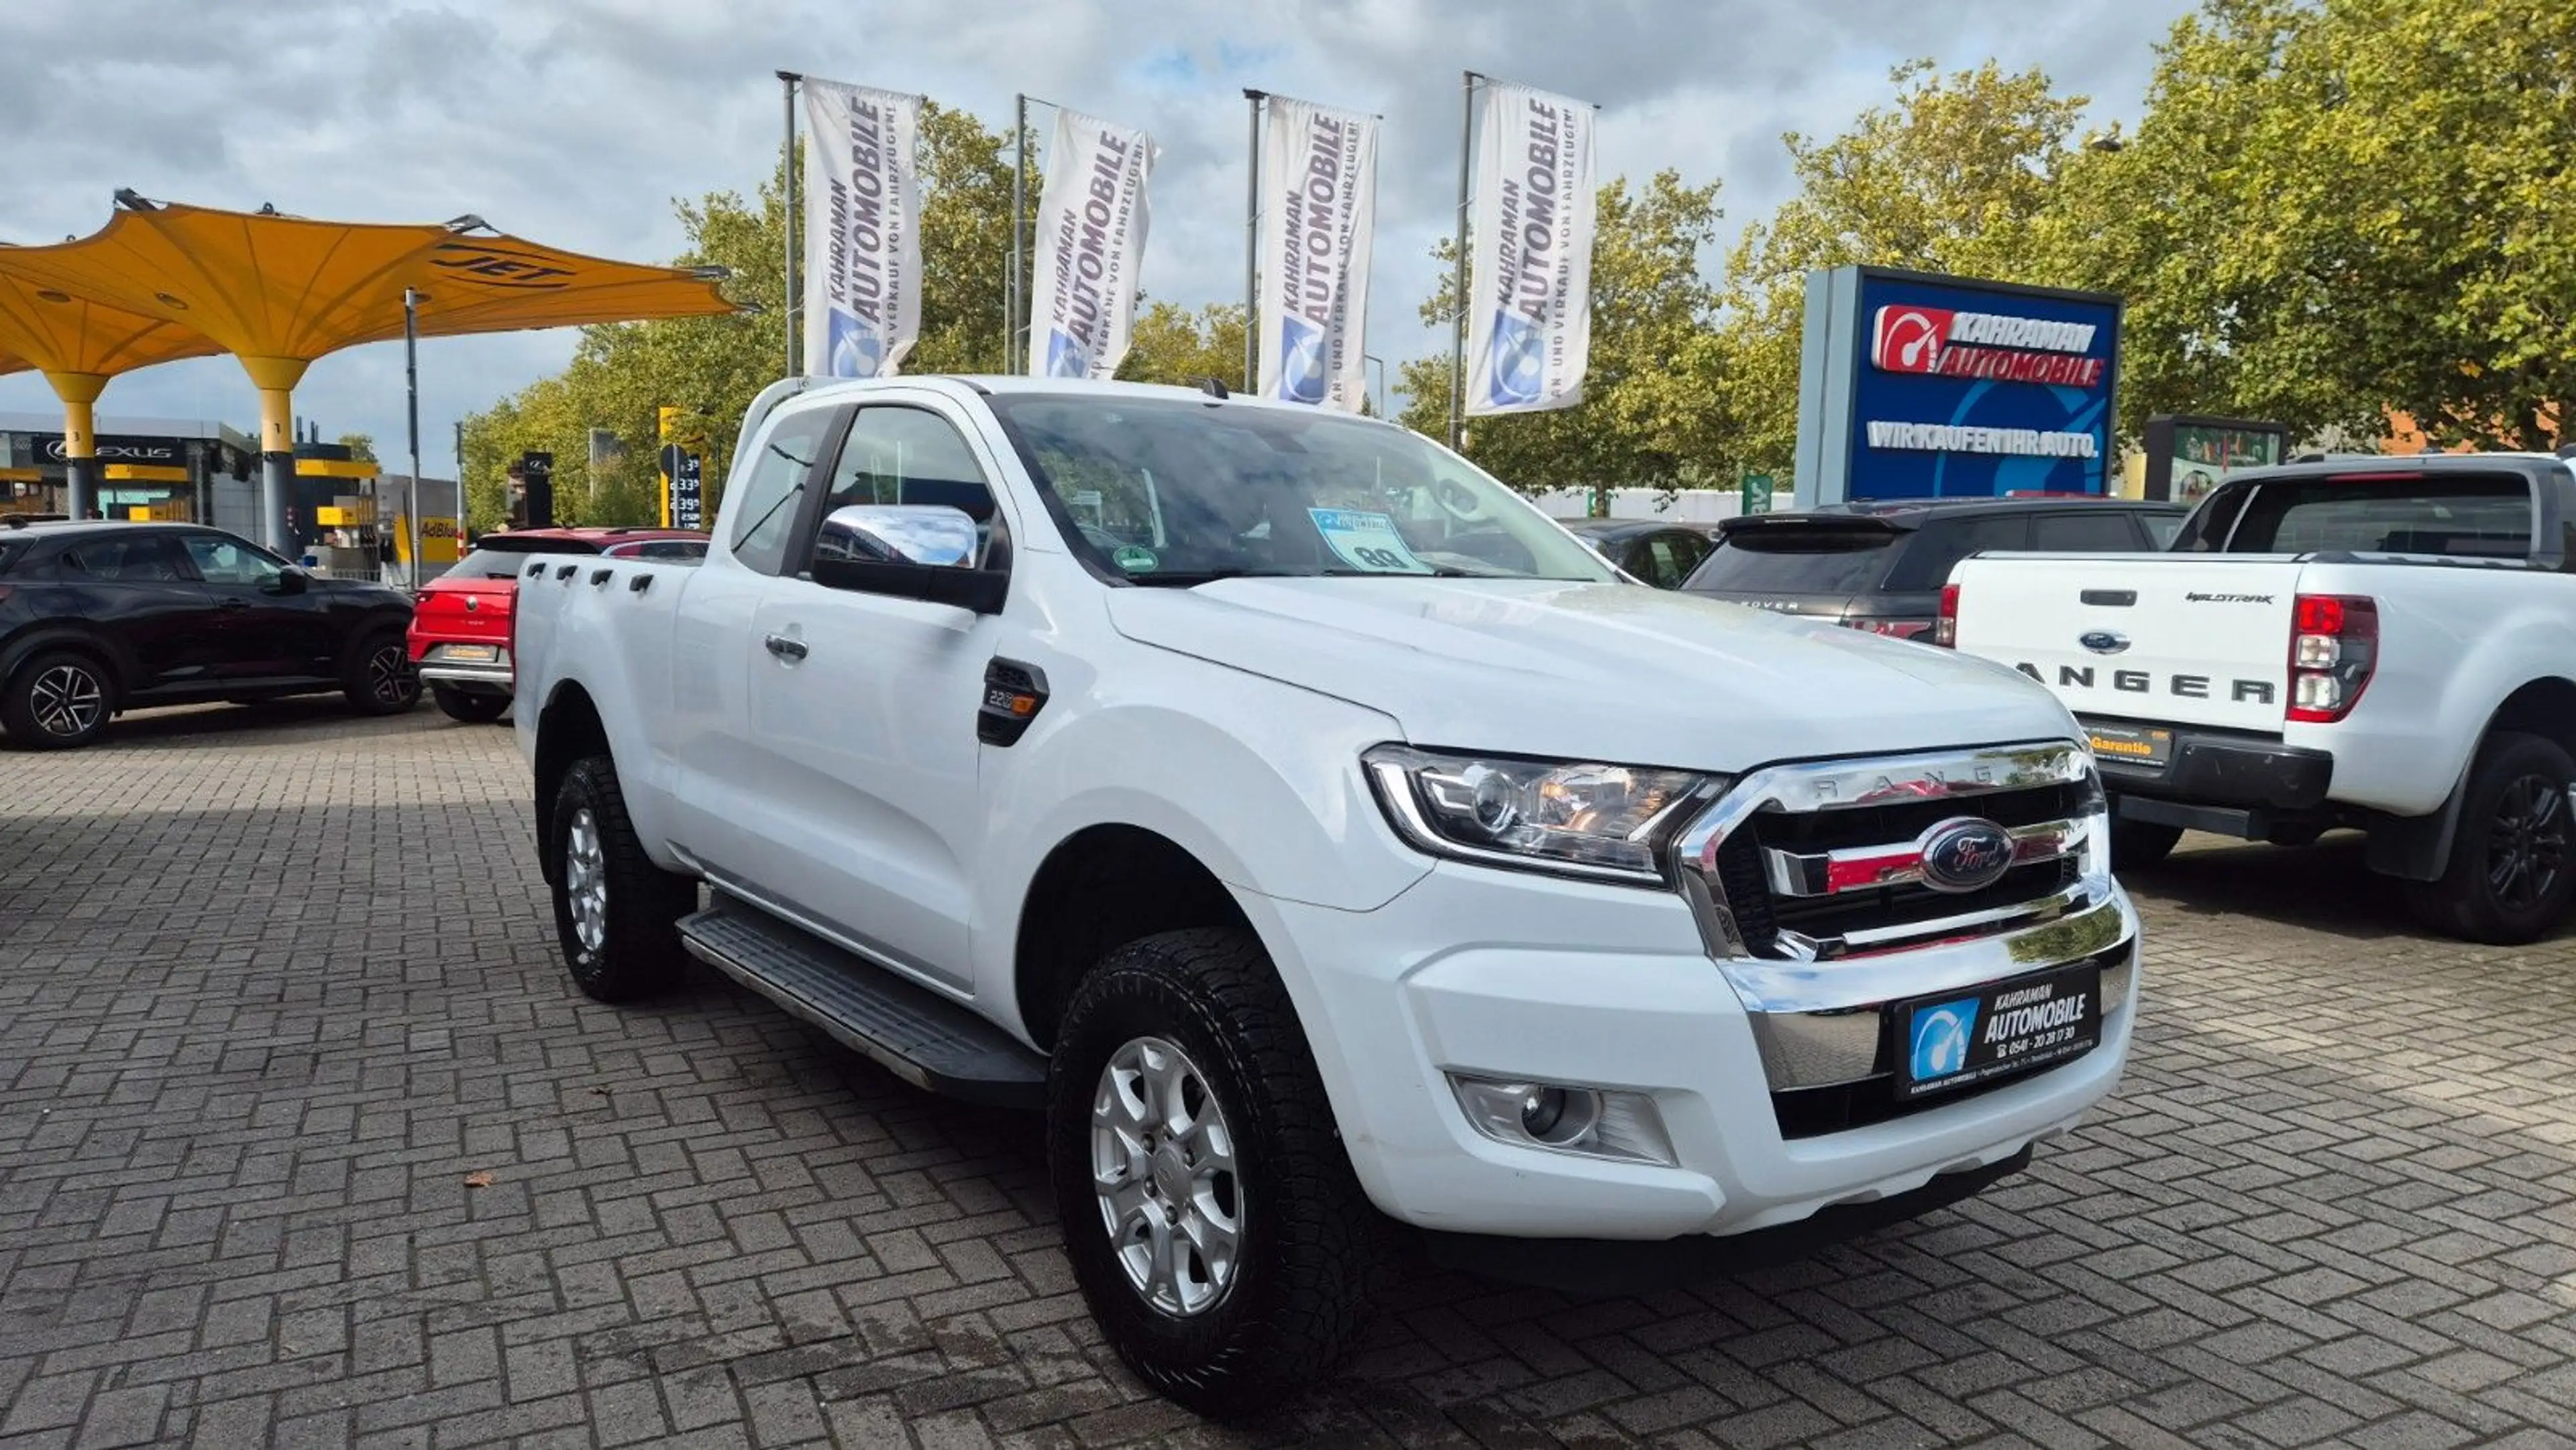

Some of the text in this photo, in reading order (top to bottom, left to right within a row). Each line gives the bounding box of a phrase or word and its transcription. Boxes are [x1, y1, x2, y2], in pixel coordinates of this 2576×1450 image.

[850, 97, 881, 325] AUTOMOBILE
[1305, 113, 1340, 327] AUTOMOBILE
[1519, 97, 1557, 323] AUTOMOBILE
[829, 178, 847, 304] KAHRAMAN
[888, 221, 900, 253] VON
[1067, 130, 1127, 347] AUTOMOBILE
[1283, 190, 1302, 312] KAHRAMAN
[1498, 178, 1519, 304] KAHRAMAN
[428, 256, 578, 280] JET
[1053, 208, 1077, 324] KAHRAMAN
[1108, 250, 1122, 282] VON
[887, 260, 899, 331] VERKAUF
[1552, 335, 1564, 366] UND
[1560, 217, 1572, 249] VON
[1947, 312, 2097, 353] KAHRAMAN
[1332, 339, 1344, 370] UND
[1937, 345, 2106, 388] AUTOMOBILE
[95, 445, 172, 458] EXUS
[1867, 421, 1913, 448] WIR
[1914, 423, 2004, 454] KAUFEN
[2004, 428, 2039, 455] IHR
[2016, 662, 2275, 704] ANGER
[2090, 736, 2152, 756] Garantie
[1953, 836, 2002, 872] Ford
[1984, 993, 2086, 1044] AUTOMOBILE
[1994, 983, 2053, 1011] KAHRAMAN
